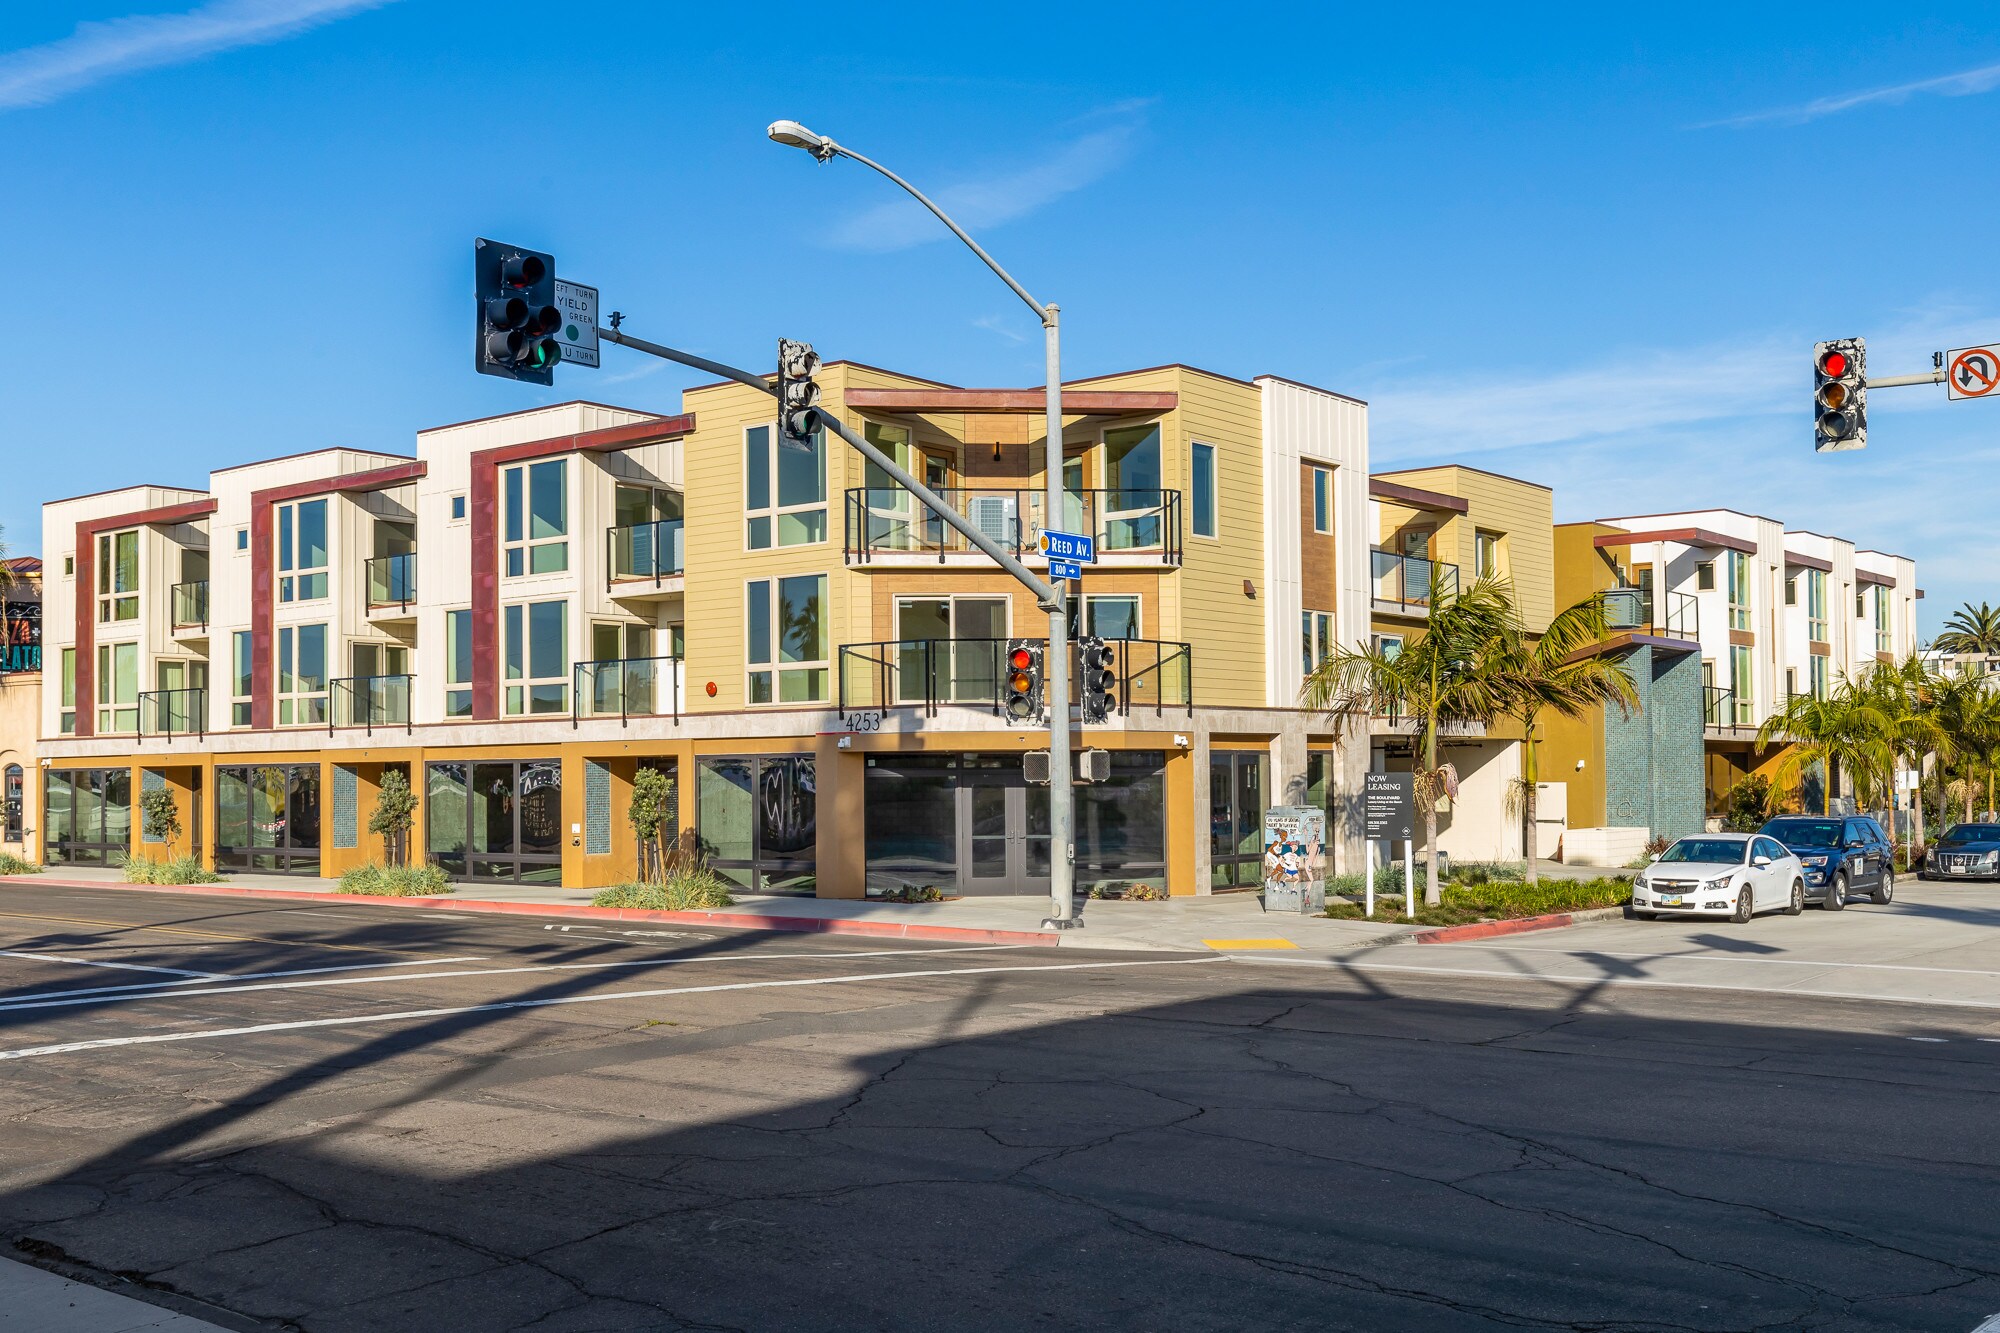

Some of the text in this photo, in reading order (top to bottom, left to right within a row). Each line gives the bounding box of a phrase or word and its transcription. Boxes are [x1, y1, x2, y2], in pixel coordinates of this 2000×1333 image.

[556, 284, 593, 300] EFT TURN
[557, 296, 588, 311] YIELD
[569, 312, 593, 324] GREEN
[565, 347, 594, 361] U TURN
[1051, 537, 1072, 554] REED
[1055, 564, 1066, 575] 800
[0, 645, 41, 670] LATO
[846, 712, 880, 731] 4253
[1367, 783, 1401, 791] LEASING
